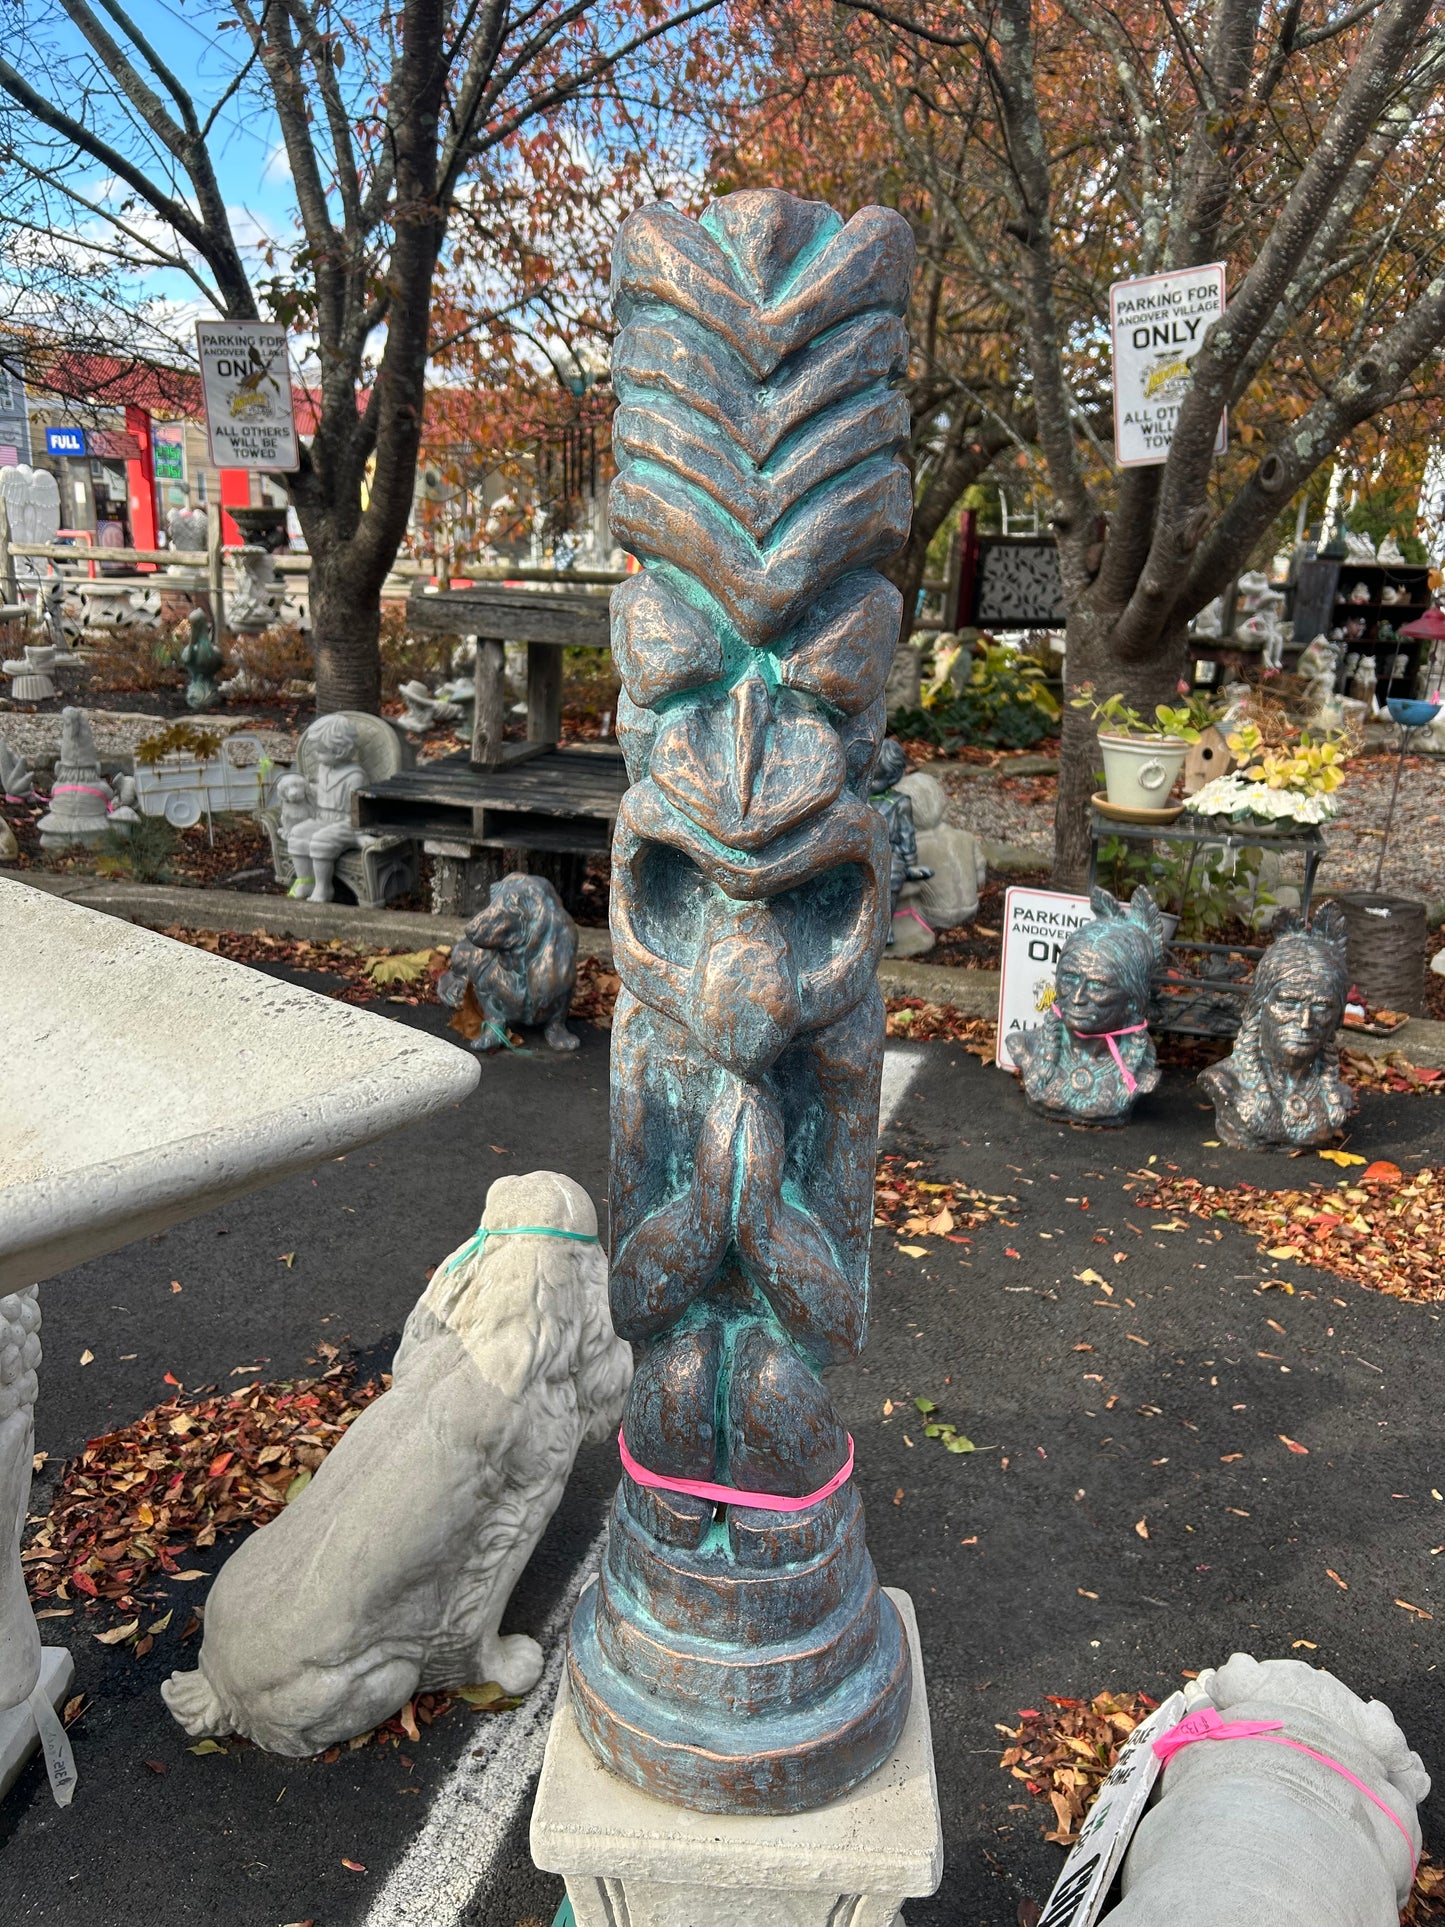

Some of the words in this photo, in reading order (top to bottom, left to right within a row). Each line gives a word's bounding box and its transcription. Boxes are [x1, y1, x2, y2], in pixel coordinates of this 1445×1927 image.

[1117, 291, 1182, 314] PARKING
[1188, 284, 1218, 301] FOR
[1117, 309, 1169, 327] ANDOVER
[1173, 300, 1220, 317] VILLAGE
[1133, 316, 1201, 349] ONLY
[202, 335, 255, 347] PARKING
[259, 335, 286, 347] FOR
[204, 348, 246, 357] ANDOVER
[1124, 409, 1152, 425] ALL
[215, 425, 238, 436] ALL
[242, 426, 290, 437] OTHERS
[1140, 420, 1173, 435] WILL
[51, 435, 80, 449] FULL
[230, 437, 259, 448] WILL
[262, 438, 278, 449] BE
[1144, 434, 1173, 448] TOW
[234, 448, 276, 459] TOWED
[1126, 1726, 1156, 1745] TAKE
[1102, 1766, 1137, 1787] HOME
